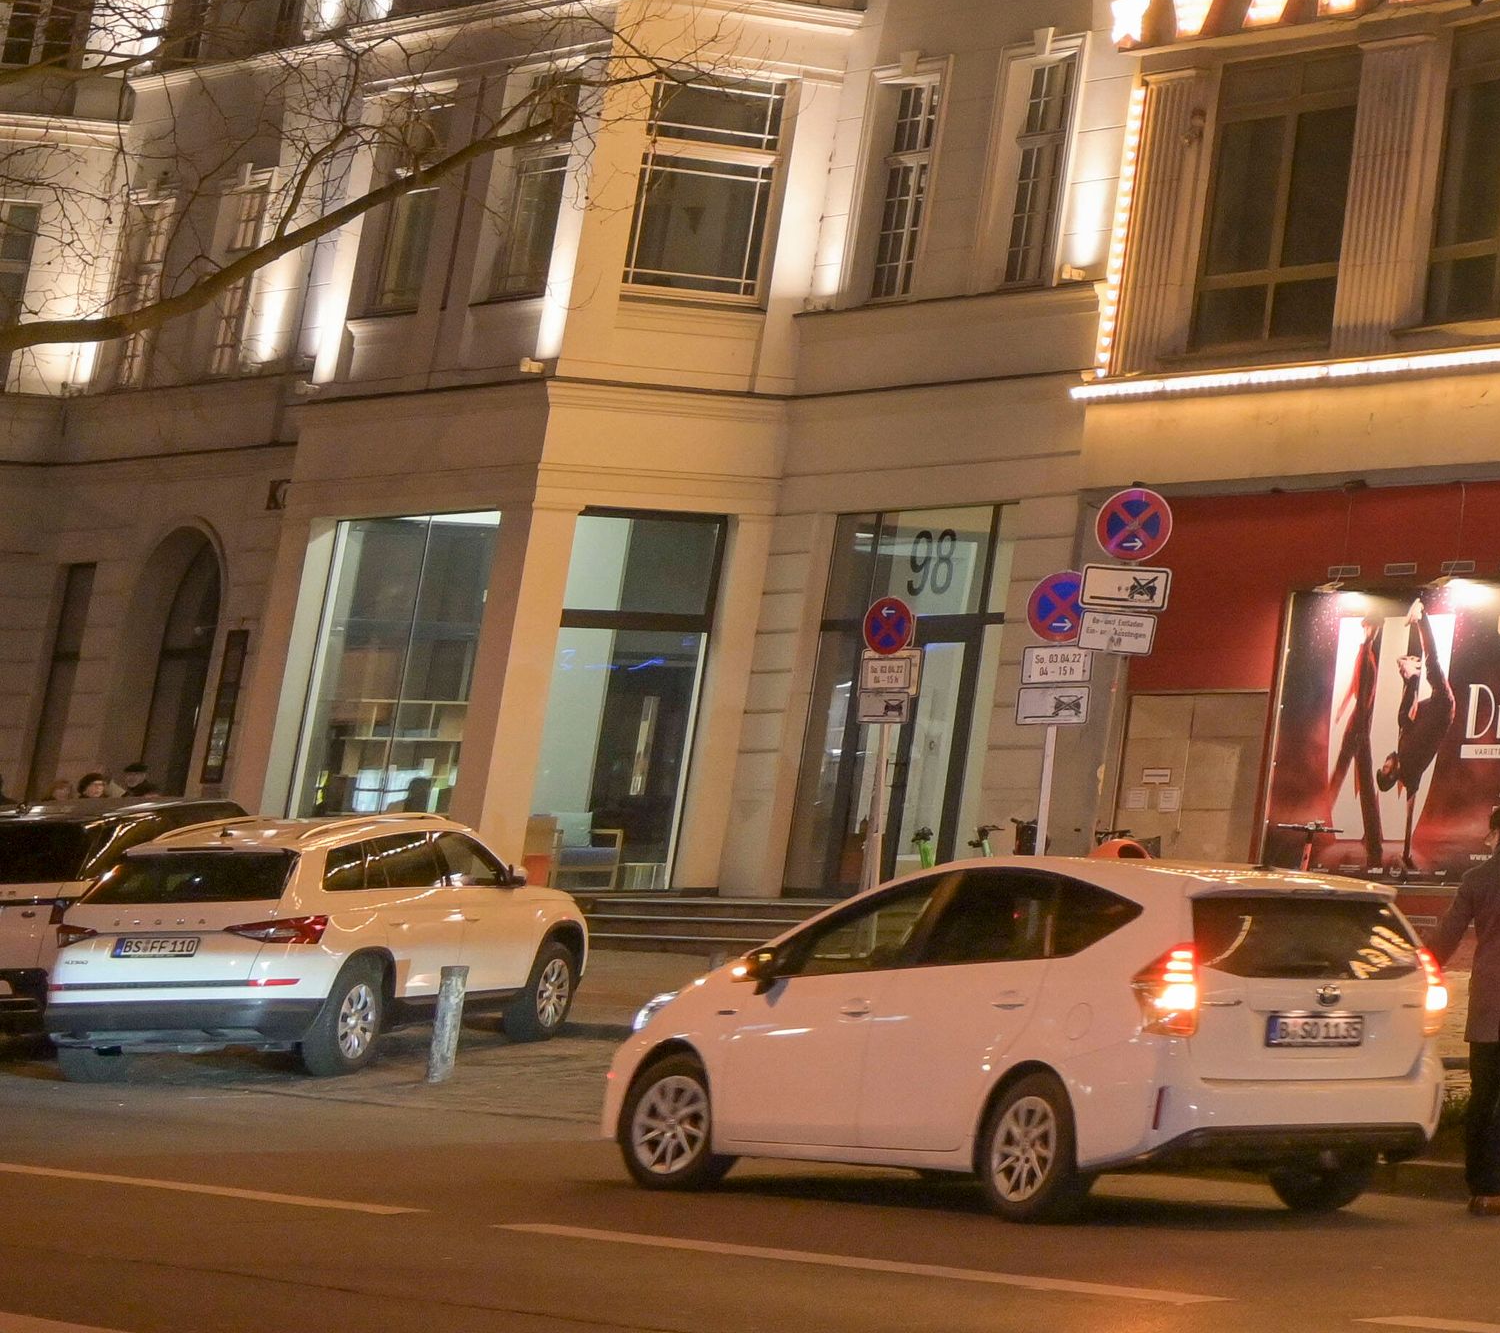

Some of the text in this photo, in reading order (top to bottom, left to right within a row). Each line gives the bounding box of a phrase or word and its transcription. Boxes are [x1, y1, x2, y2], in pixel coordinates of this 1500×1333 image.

[906, 528, 957, 596] 98
[150, 940, 167, 953] FF
[171, 939, 196, 954] 110
